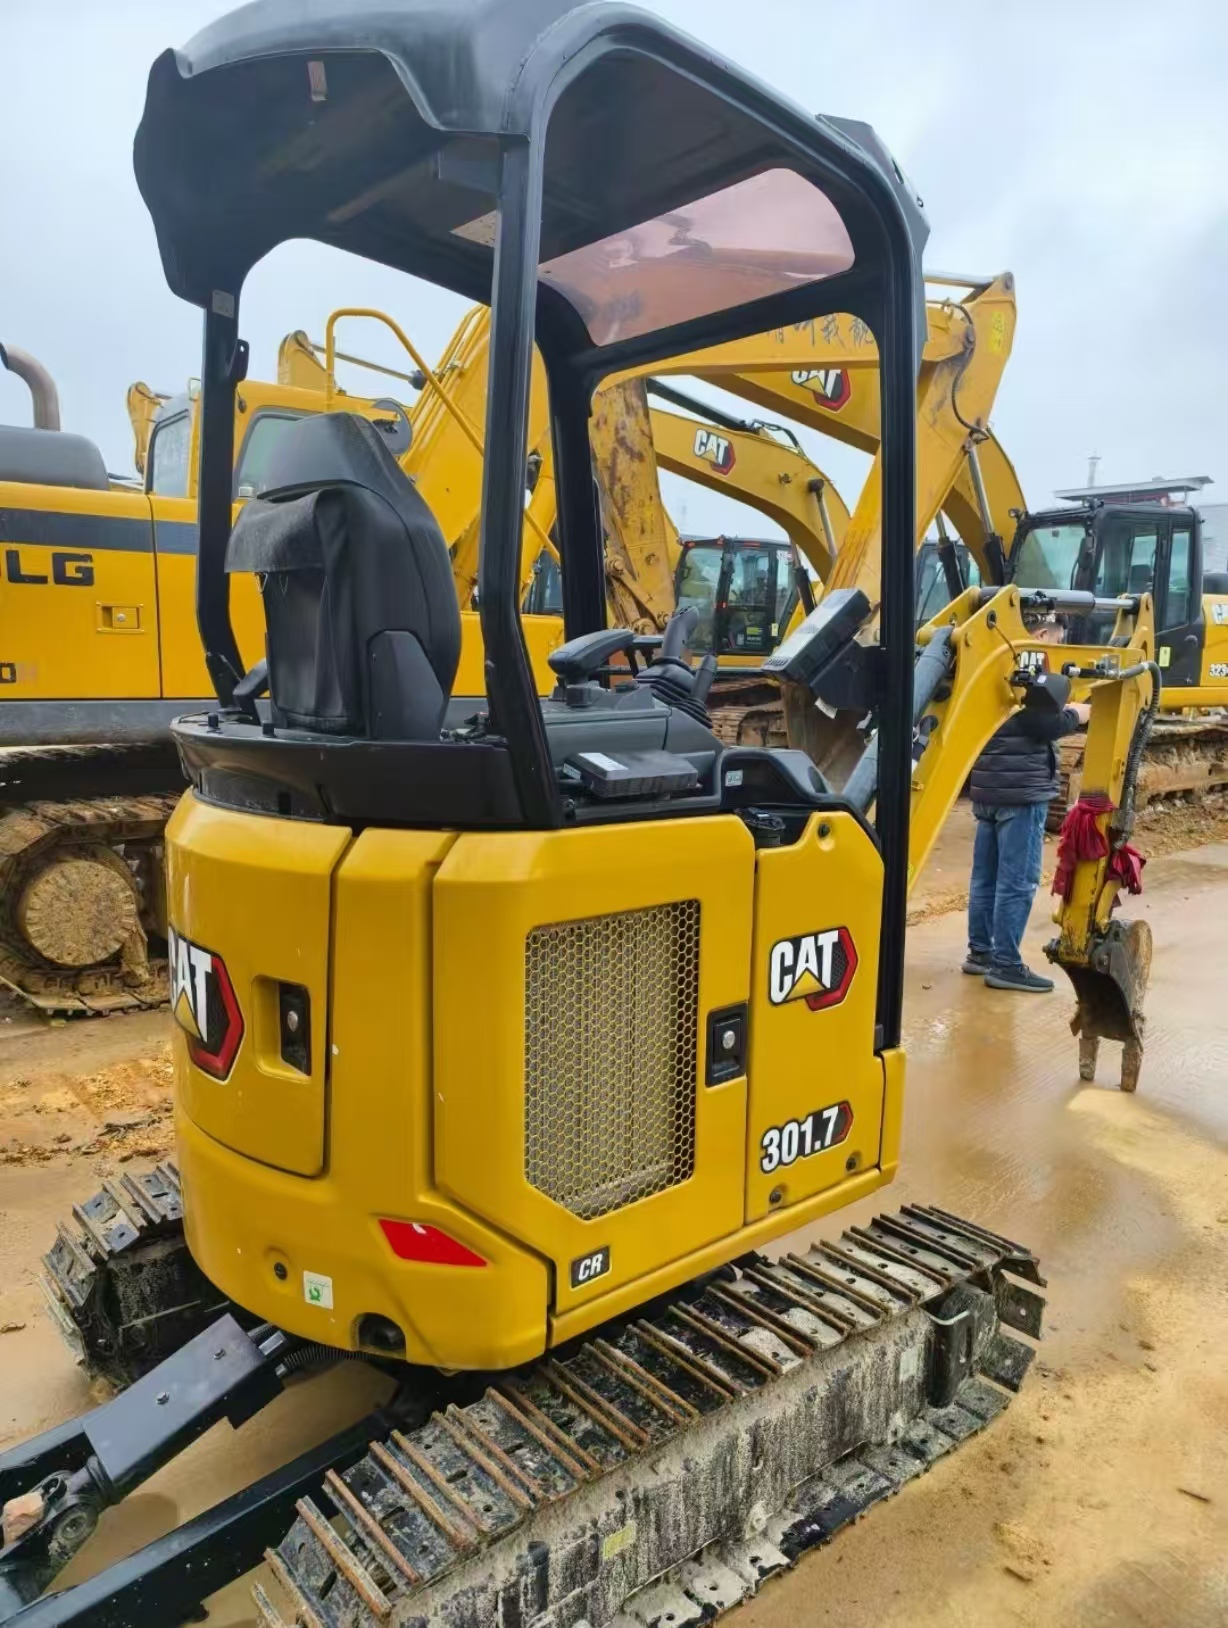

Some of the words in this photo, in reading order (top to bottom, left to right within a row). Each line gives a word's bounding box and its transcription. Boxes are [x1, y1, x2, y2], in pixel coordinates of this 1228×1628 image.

[694, 429, 729, 465] CAT
[0, 549, 95, 587] LG
[770, 929, 839, 1004] CAT
[762, 1105, 839, 1172] 301.7
[578, 1253, 603, 1281] CR
